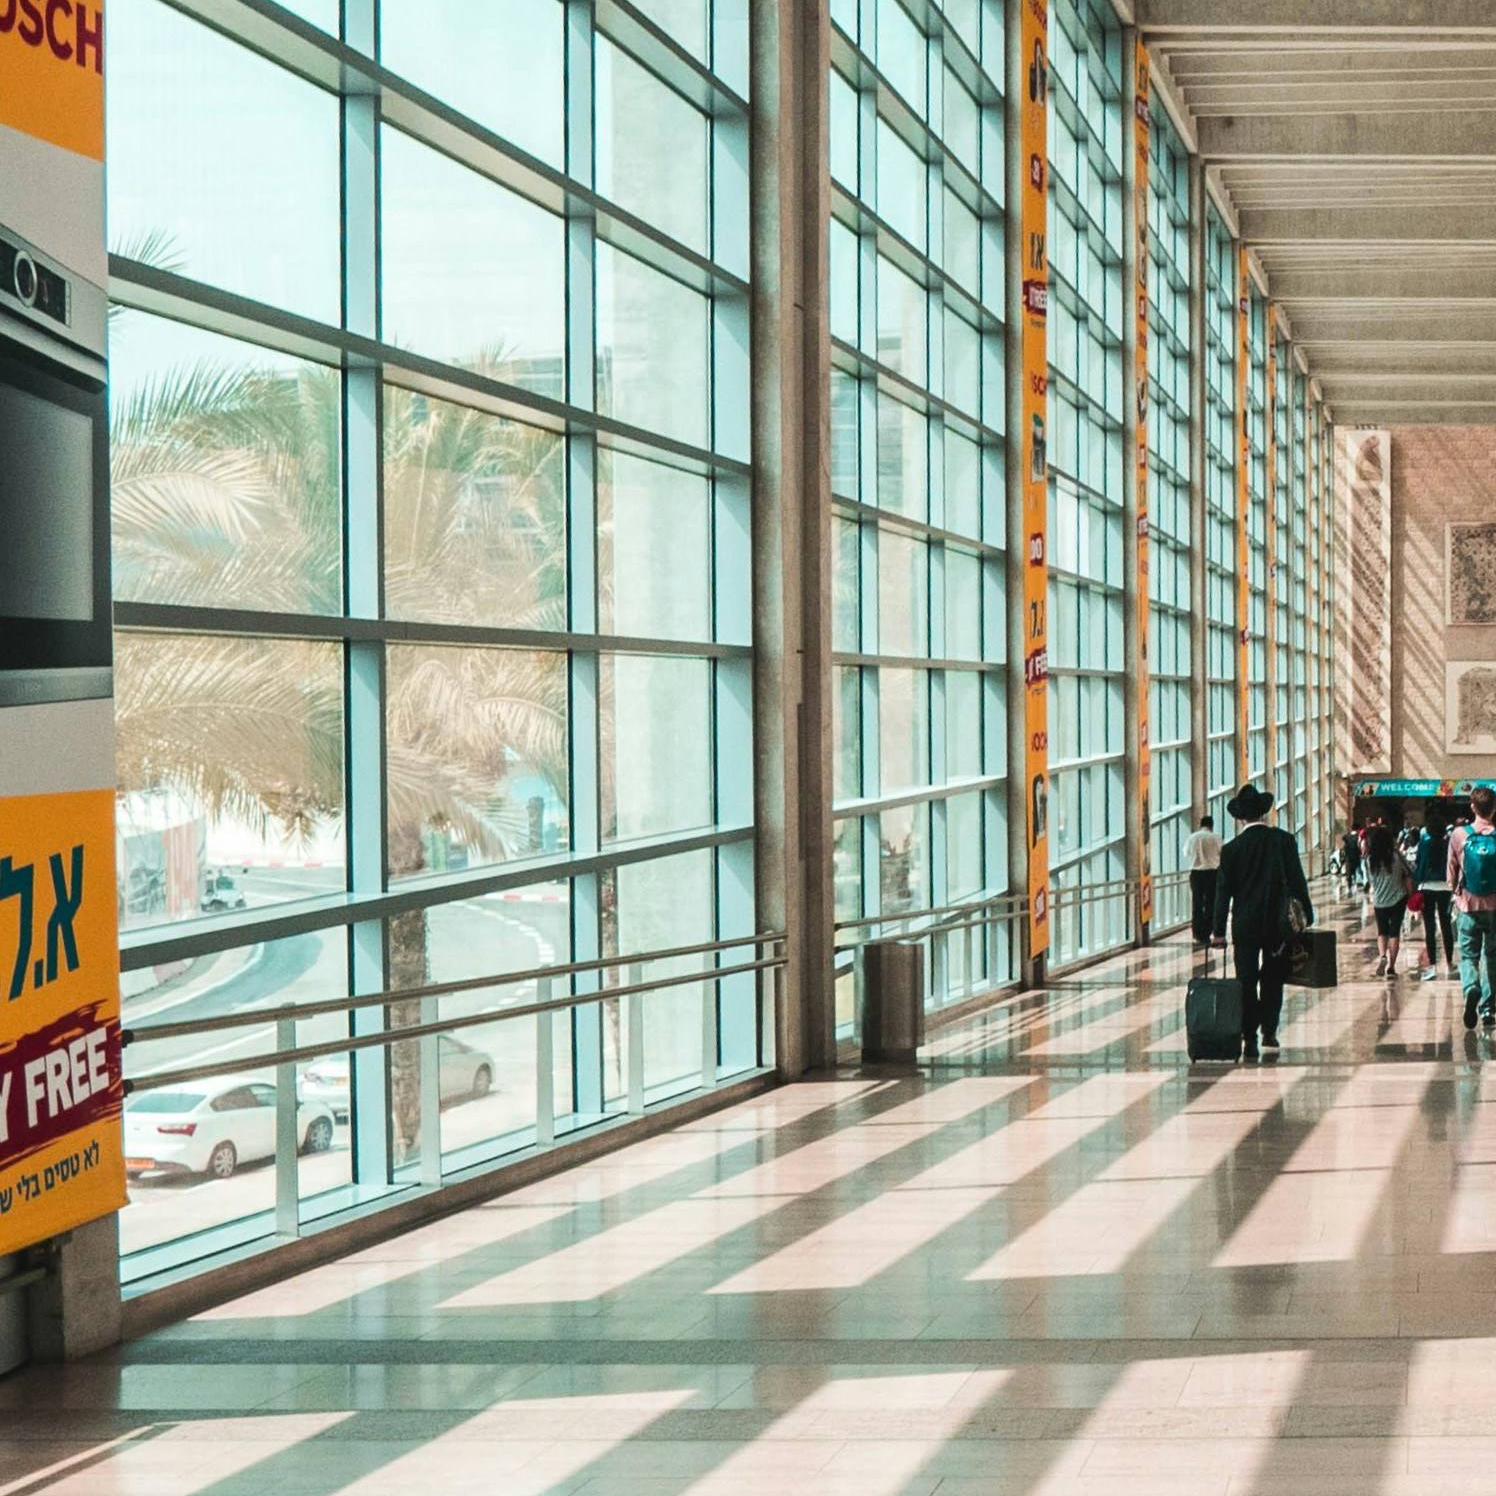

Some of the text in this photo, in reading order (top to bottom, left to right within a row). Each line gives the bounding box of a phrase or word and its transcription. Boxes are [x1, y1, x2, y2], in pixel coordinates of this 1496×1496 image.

[1381, 783, 1434, 792] WELCOME
[24, 1027, 110, 1128] FREE
[84, 1140, 100, 1171] לא
[17, 1174, 40, 1201] בלי
[44, 1153, 80, 1191] טסים
